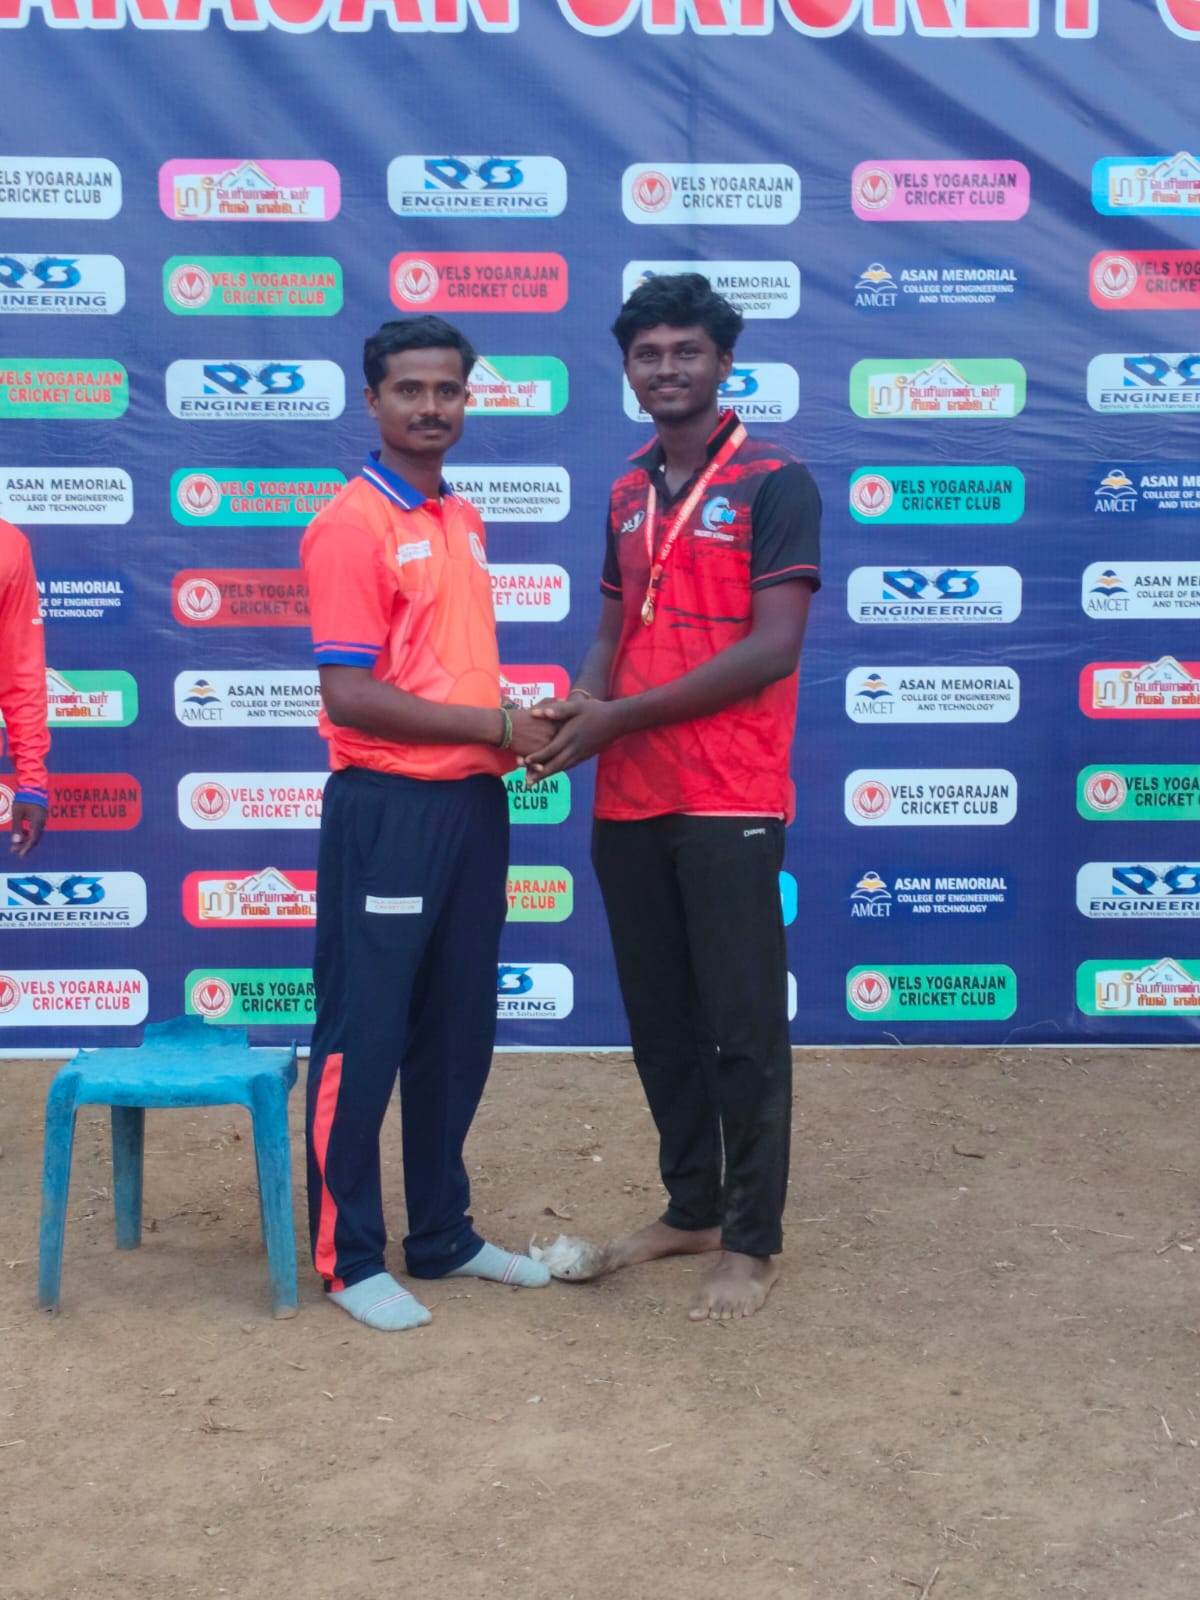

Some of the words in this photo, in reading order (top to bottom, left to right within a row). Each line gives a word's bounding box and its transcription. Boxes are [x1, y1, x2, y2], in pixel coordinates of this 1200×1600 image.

[26, 171, 112, 186] YOGARAJAN
[672, 177, 705, 191] VELS
[711, 177, 793, 191] YOGARAJAN
[894, 174, 928, 188] VELS
[934, 173, 1016, 187] YOGARAJAN
[64, 189, 101, 203] CLUB
[402, 196, 548, 206] ENGINEERING
[682, 194, 742, 208] CRICKET
[747, 195, 782, 208] CLUB
[905, 190, 965, 205] CRICKET
[969, 191, 1005, 205] CLUB
[438, 266, 470, 280] VELS
[475, 266, 559, 280] YOGARAJAN
[900, 270, 938, 281] ASAN
[942, 269, 1017, 281] MEMORIAL
[1136, 261, 1170, 276] VELS
[212, 273, 246, 288] VELS
[251, 273, 335, 288] YOGARAJAN
[717, 277, 791, 288] MEMORIAL
[448, 283, 507, 298] CRICKET
[512, 284, 547, 298] CLUB
[903, 285, 941, 293] COLLEGE
[942, 285, 954, 293] OF
[955, 285, 1014, 293] ENGINEERING
[223, 290, 284, 304] CRICKET
[288, 290, 324, 304] CLUB
[855, 292, 897, 306] AMCET
[919, 295, 938, 303] AND
[940, 295, 995, 303] TECHNOLOGY
[37, 372, 122, 386] YOGARAJAN
[9, 388, 69, 402] CRICKET
[74, 389, 111, 403] CLUB
[181, 401, 329, 411] ENGINEERING
[7, 479, 44, 489] ASAN
[51, 479, 126, 490] MEMORIAL
[490, 482, 562, 492] MEMORIAL
[892, 480, 925, 494] VELS
[930, 480, 1012, 494] YOGARAJAN
[1141, 476, 1178, 487] ASAN
[220, 482, 254, 496] VELS
[1143, 491, 1181, 499] COLLEGE
[232, 498, 290, 512] CRICKET
[902, 497, 961, 510] CRICKET
[966, 497, 1000, 510] CLUB
[1095, 496, 1137, 512] AMCET
[50, 581, 123, 593] MEMORIAL
[1135, 576, 1171, 586] ASAN
[219, 584, 254, 598] VELS
[51, 598, 62, 606] OF
[64, 598, 121, 606] ENGINEERING
[516, 592, 550, 605] CLUB
[231, 601, 288, 615] CRICKET
[861, 606, 1002, 615] ENGINEERING
[1087, 599, 1130, 612] AMCET
[48, 609, 104, 617] TECHNOLOGY
[228, 686, 264, 696] ASAN
[899, 680, 935, 690] ASAN
[942, 680, 1013, 689] MEMORIAL
[181, 707, 223, 720] AMCET
[853, 701, 895, 714] AMCET
[1125, 777, 1158, 790] VELS
[55, 788, 137, 802] YOGARAJAN
[229, 789, 264, 802] VELS
[891, 786, 923, 798] VELS
[929, 785, 1008, 798] YOGARAJAN
[514, 796, 548, 809] CLUB
[1136, 793, 1193, 806] CRICKET
[91, 805, 126, 818] CLUB
[242, 804, 300, 817] CRICKET
[902, 801, 959, 814] CRICKET
[964, 801, 998, 814] CLUB
[895, 878, 930, 890] ASAN
[935, 878, 1007, 890] MEMORIAL
[521, 896, 555, 909] CLUB
[897, 894, 933, 902] COLLEGE
[935, 894, 946, 902] OF
[948, 894, 1004, 902] ENGINEERING
[851, 902, 892, 917] AMCET
[913, 905, 931, 913] AND
[933, 905, 987, 913] TECHNOLOGY
[19, 981, 54, 994] VELS
[60, 981, 140, 994] YOGARAJAN
[231, 983, 264, 996] VELS
[889, 977, 921, 990] VELS
[927, 976, 1005, 989] YOGARAJAN
[33, 997, 90, 1010] CRICKET
[96, 996, 130, 1009] CLUB
[900, 992, 956, 1005] CRICKET
[961, 992, 995, 1005] CLUB
[242, 999, 300, 1012] CRICKET
